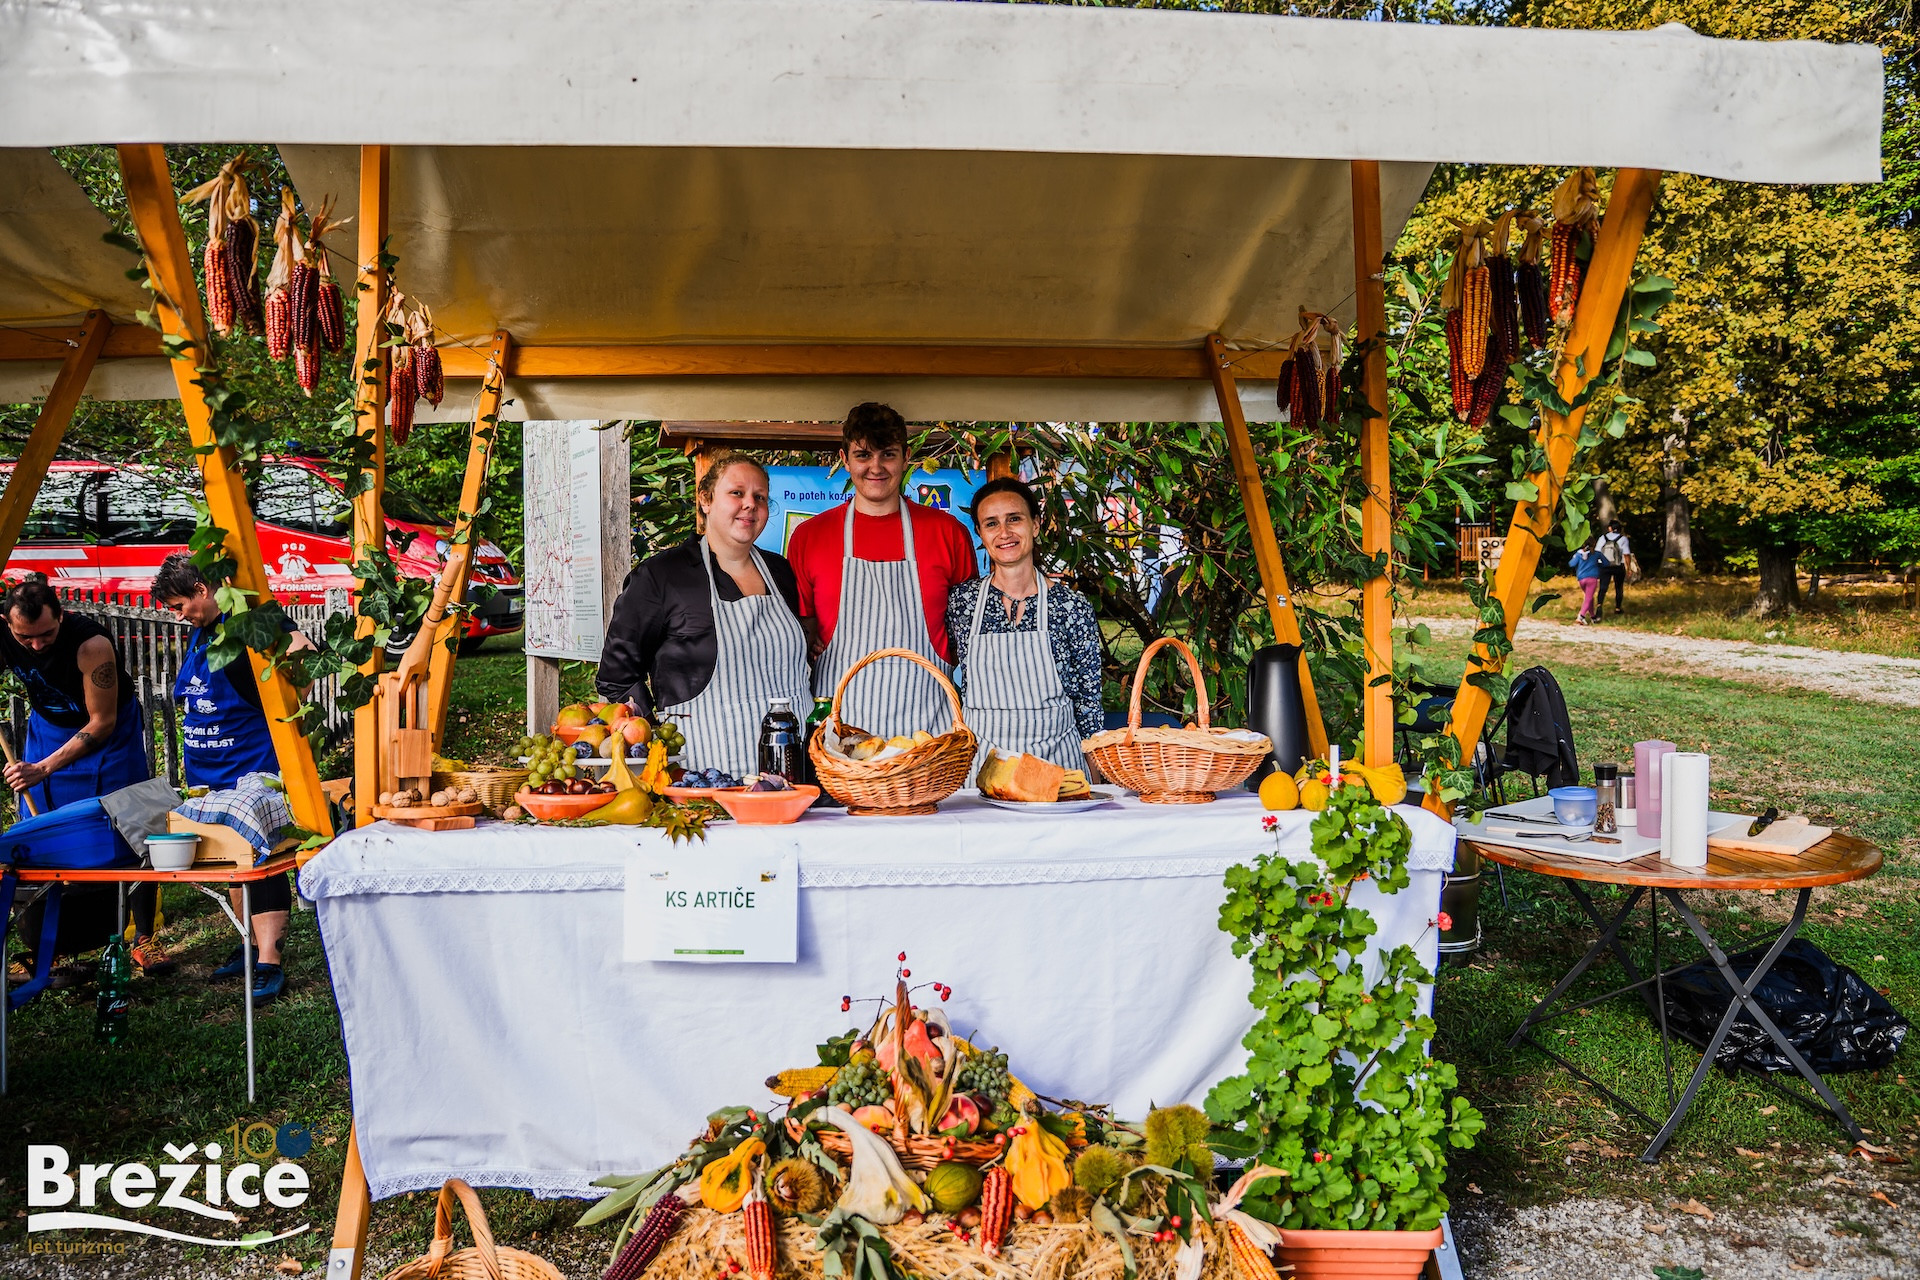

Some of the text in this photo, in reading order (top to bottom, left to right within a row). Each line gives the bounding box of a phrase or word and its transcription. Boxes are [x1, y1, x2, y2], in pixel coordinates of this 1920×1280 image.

[784, 490, 796, 500] Po
[799, 490, 826, 502] poteh
[666, 886, 756, 908] KS ARTIČE
